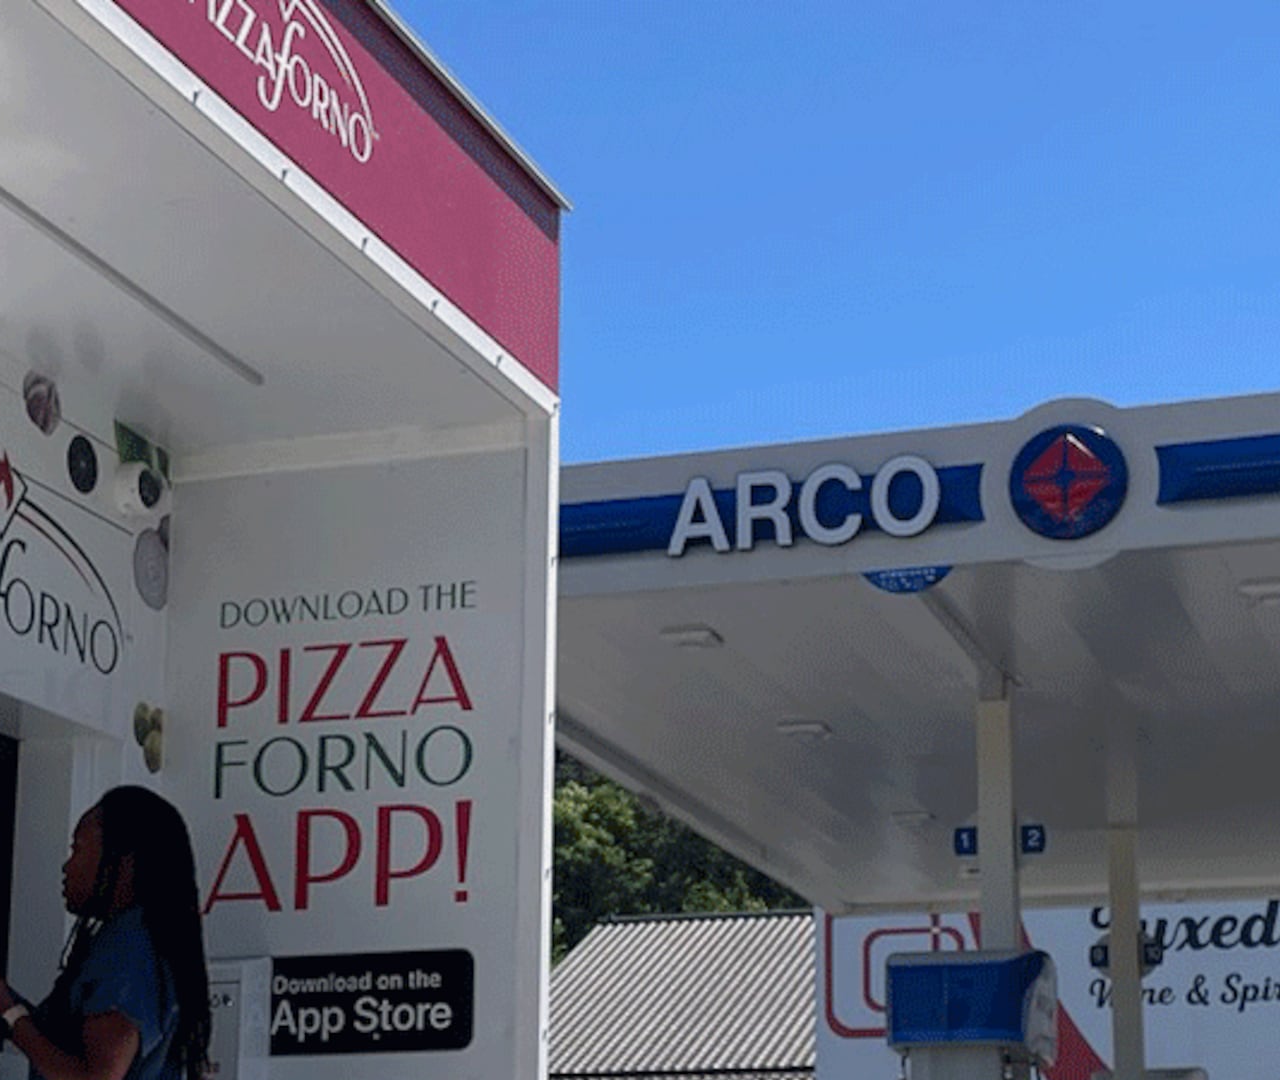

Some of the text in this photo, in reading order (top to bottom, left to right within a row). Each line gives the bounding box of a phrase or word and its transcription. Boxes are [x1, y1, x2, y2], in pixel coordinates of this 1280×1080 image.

[668, 455, 941, 557] ARCO
[220, 581, 476, 628] DOWNLOAD THE
[216, 636, 473, 728] PIZZA
[213, 725, 473, 799] FORNO
[201, 800, 472, 914] APP!
[961, 832, 969, 848] 1
[1028, 829, 1040, 846] 2
[272, 969, 442, 994] Download on the
[1089, 977, 1175, 1008] Wne
[1185, 973, 1210, 1006] &
[270, 996, 452, 1042] App Store
